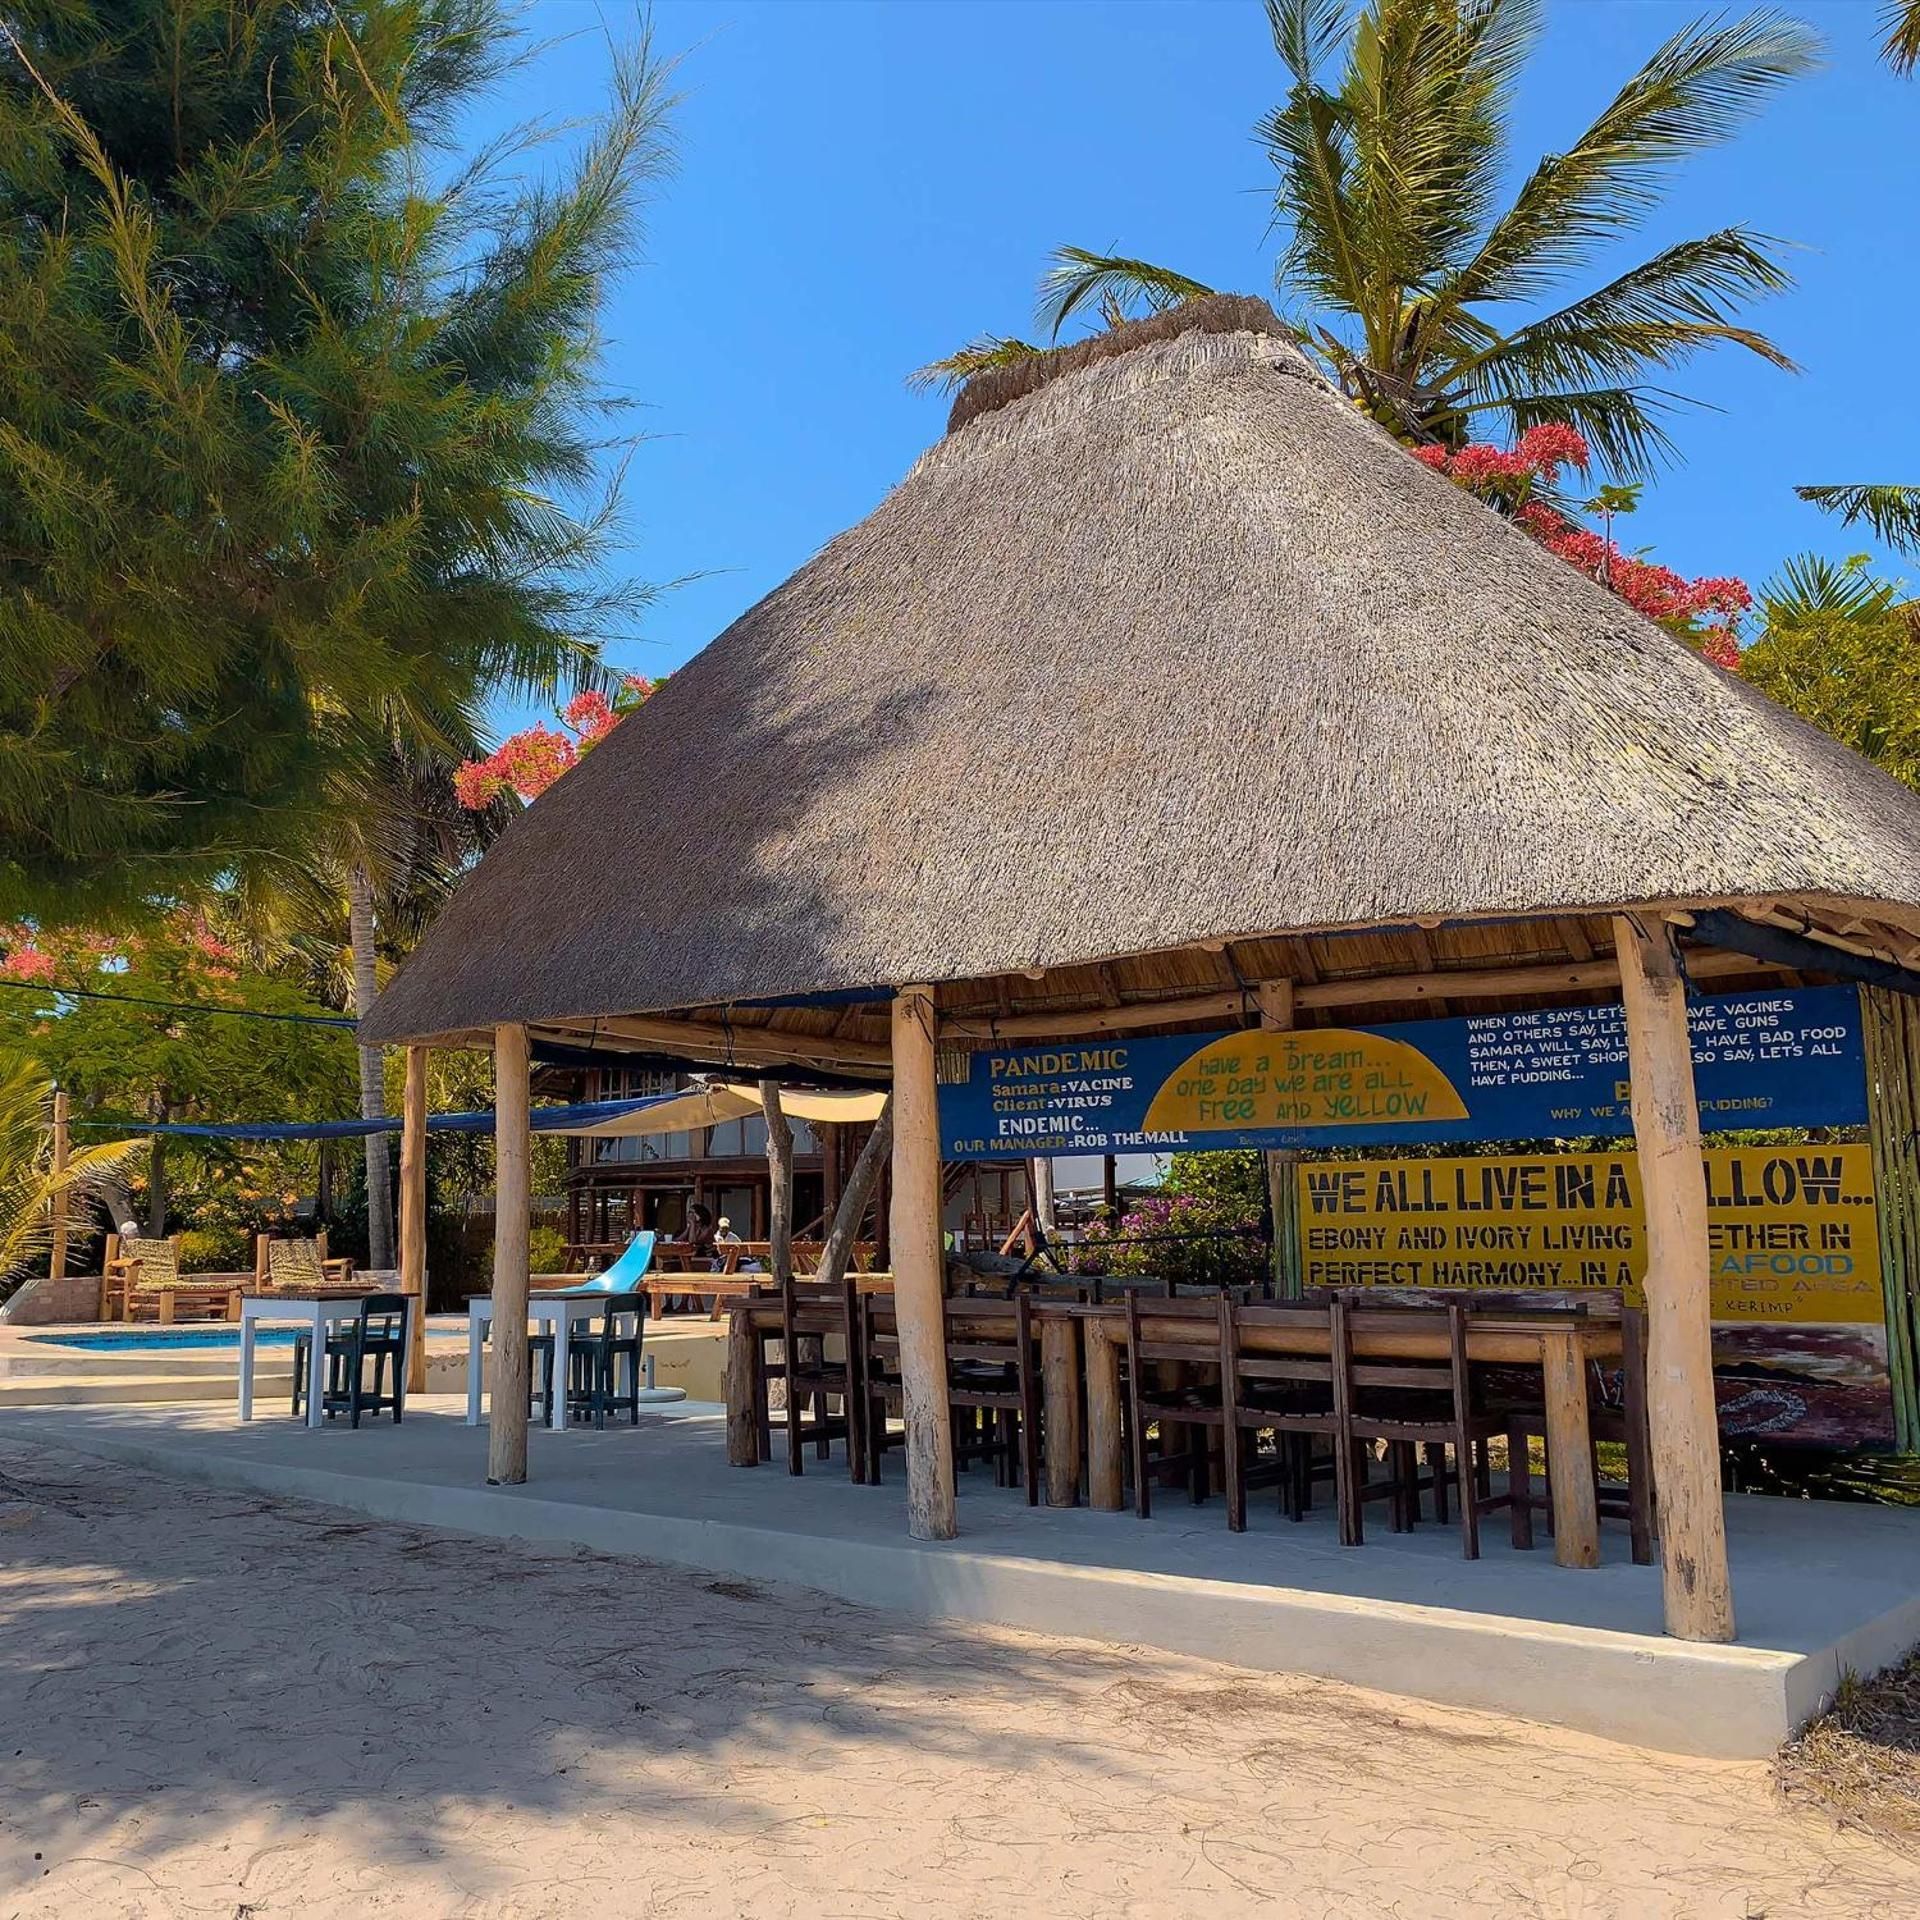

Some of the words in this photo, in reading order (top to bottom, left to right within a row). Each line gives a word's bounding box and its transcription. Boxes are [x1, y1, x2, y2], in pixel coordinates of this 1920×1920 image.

[1467, 1017, 1507, 1031] WHEN
[1512, 1014, 1542, 1027] ONE
[1588, 1005, 1628, 1021] LET'S
[1686, 1006, 1716, 1019] AVE
[1724, 1000, 1794, 1016] VACINES
[1468, 1032, 1497, 1045] AND
[1503, 1026, 1564, 1042] OTHERS
[1735, 1015, 1780, 1029] GUNS
[1469, 1043, 1536, 1059] SAMARA
[1539, 1041, 1575, 1053] WILL
[1705, 1033, 1751, 1048] HAVE
[1801, 1026, 1848, 1041] FOOD
[1284, 1040, 1300, 1051] I
[1470, 1060, 1511, 1073] THEN,
[1514, 1059, 1526, 1070] A
[1531, 1054, 1582, 1069] SWEET
[1588, 1051, 1629, 1065] SHOP
[1760, 1042, 1804, 1060] LET'S
[1810, 1043, 1843, 1056] ALL
[990, 1048, 1128, 1078] PANDEMIC
[1256, 1055, 1270, 1073] a
[1176, 1077, 1217, 1097] one
[1313, 1072, 1353, 1093] are
[1471, 1073, 1507, 1087] HAVE
[1511, 1069, 1585, 1085] PUDDING...
[1551, 1107, 1582, 1120] WHY
[1591, 1105, 1616, 1118] WE
[1699, 1097, 1774, 1112] PUDDING?
[998, 1114, 1099, 1136] ENDEMIC...
[954, 1139, 985, 1153] OUR
[1112, 1129, 1189, 1146] THEMALL
[1307, 1171, 1367, 1214] WE
[1375, 1168, 1449, 1213] ALL
[1455, 1165, 1548, 1211] LIVE
[1554, 1163, 1596, 1210] IN
[1604, 1163, 1633, 1209] A
[1703, 1156, 1875, 1207] LLOW...
[1308, 1226, 1387, 1250] EBONY
[1398, 1226, 1447, 1249] AND
[1455, 1225, 1532, 1250] IVORY
[1543, 1224, 1633, 1250] LIVING
[1820, 1223, 1851, 1249] IN
[1309, 1260, 1424, 1285] PERFECT
[1616, 1261, 1634, 1286] A
